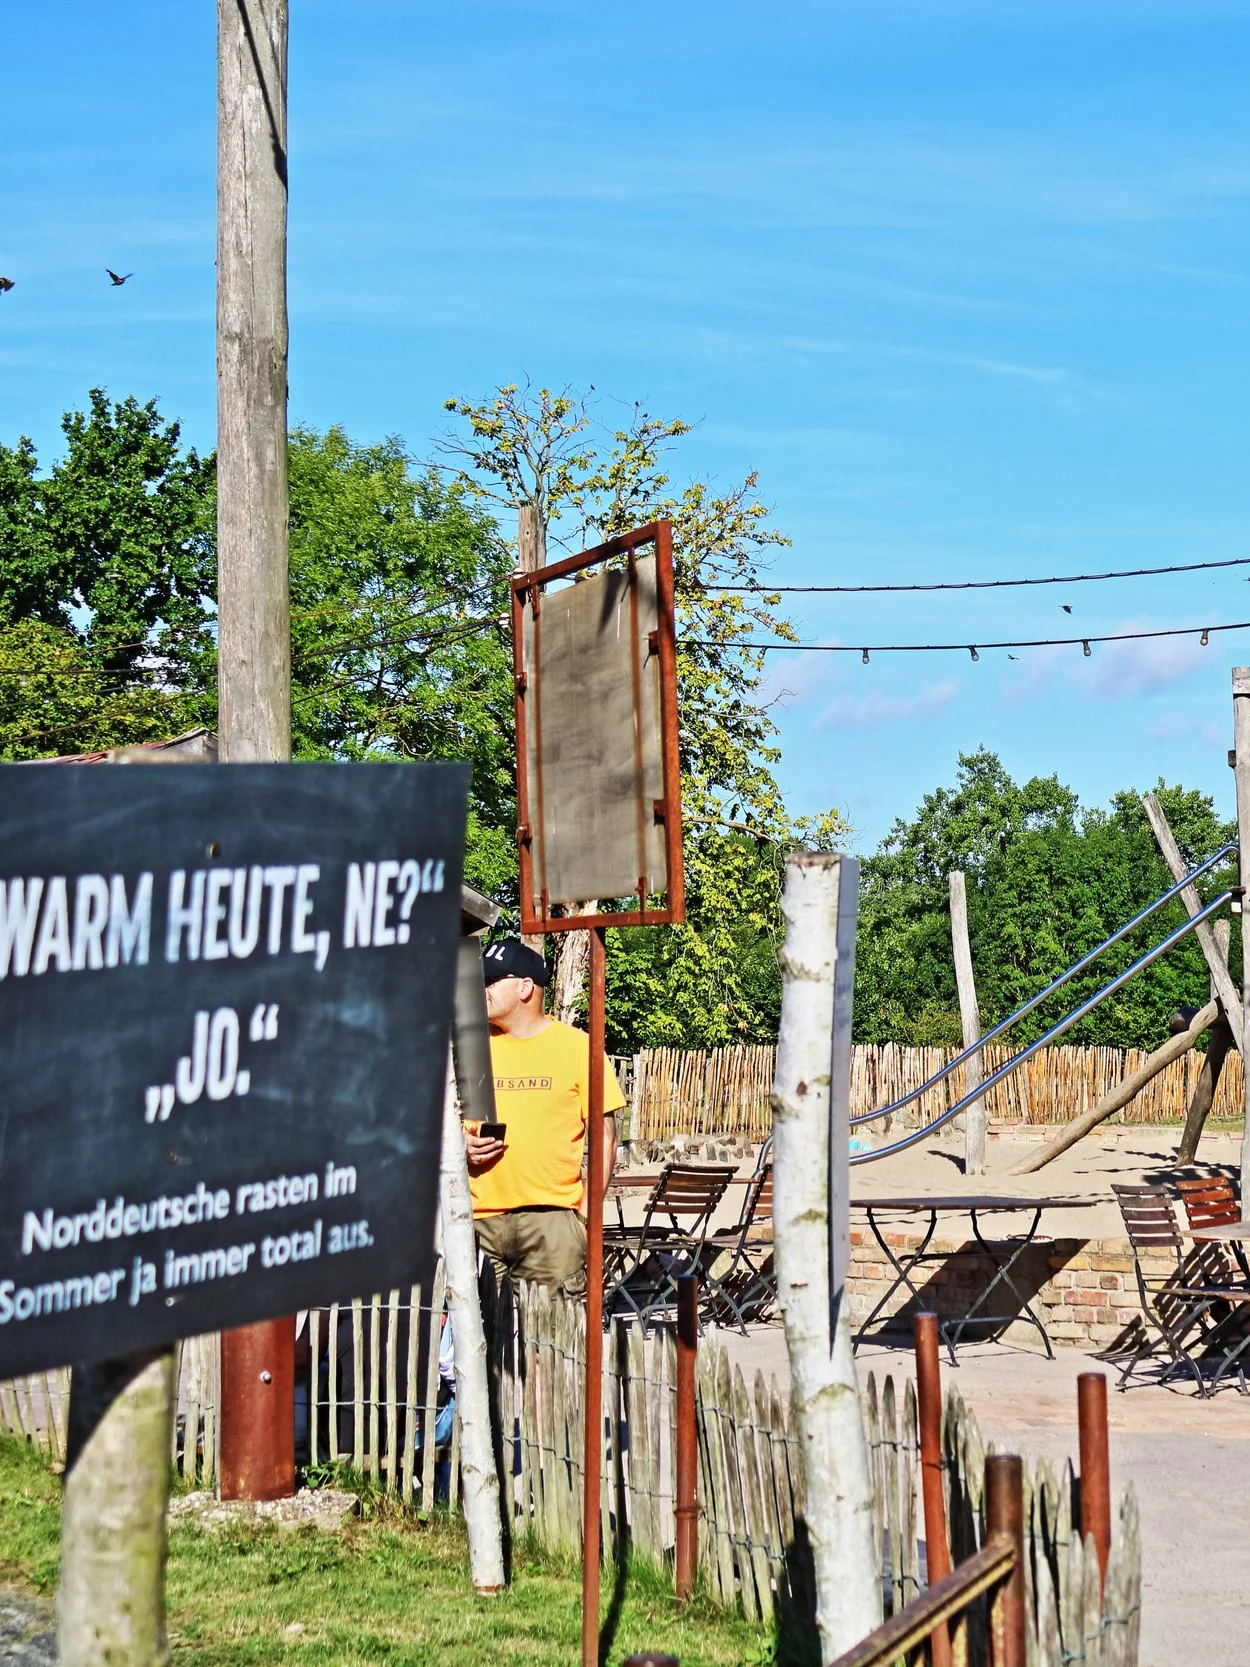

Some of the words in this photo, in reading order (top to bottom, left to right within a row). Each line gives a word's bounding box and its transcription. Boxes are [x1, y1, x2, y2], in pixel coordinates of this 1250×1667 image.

[0, 871, 154, 980] WARM
[165, 863, 331, 973] HEUTE,
[21, 1182, 231, 1255] Norddeutsche
[235, 1173, 319, 1215] rasten
[324, 1161, 357, 1198] im
[0, 1269, 126, 1324] Sommer
[129, 1256, 157, 1306] ja
[164, 1242, 256, 1289] immer
[261, 1219, 323, 1268] total
[328, 1219, 374, 1254] aus.
